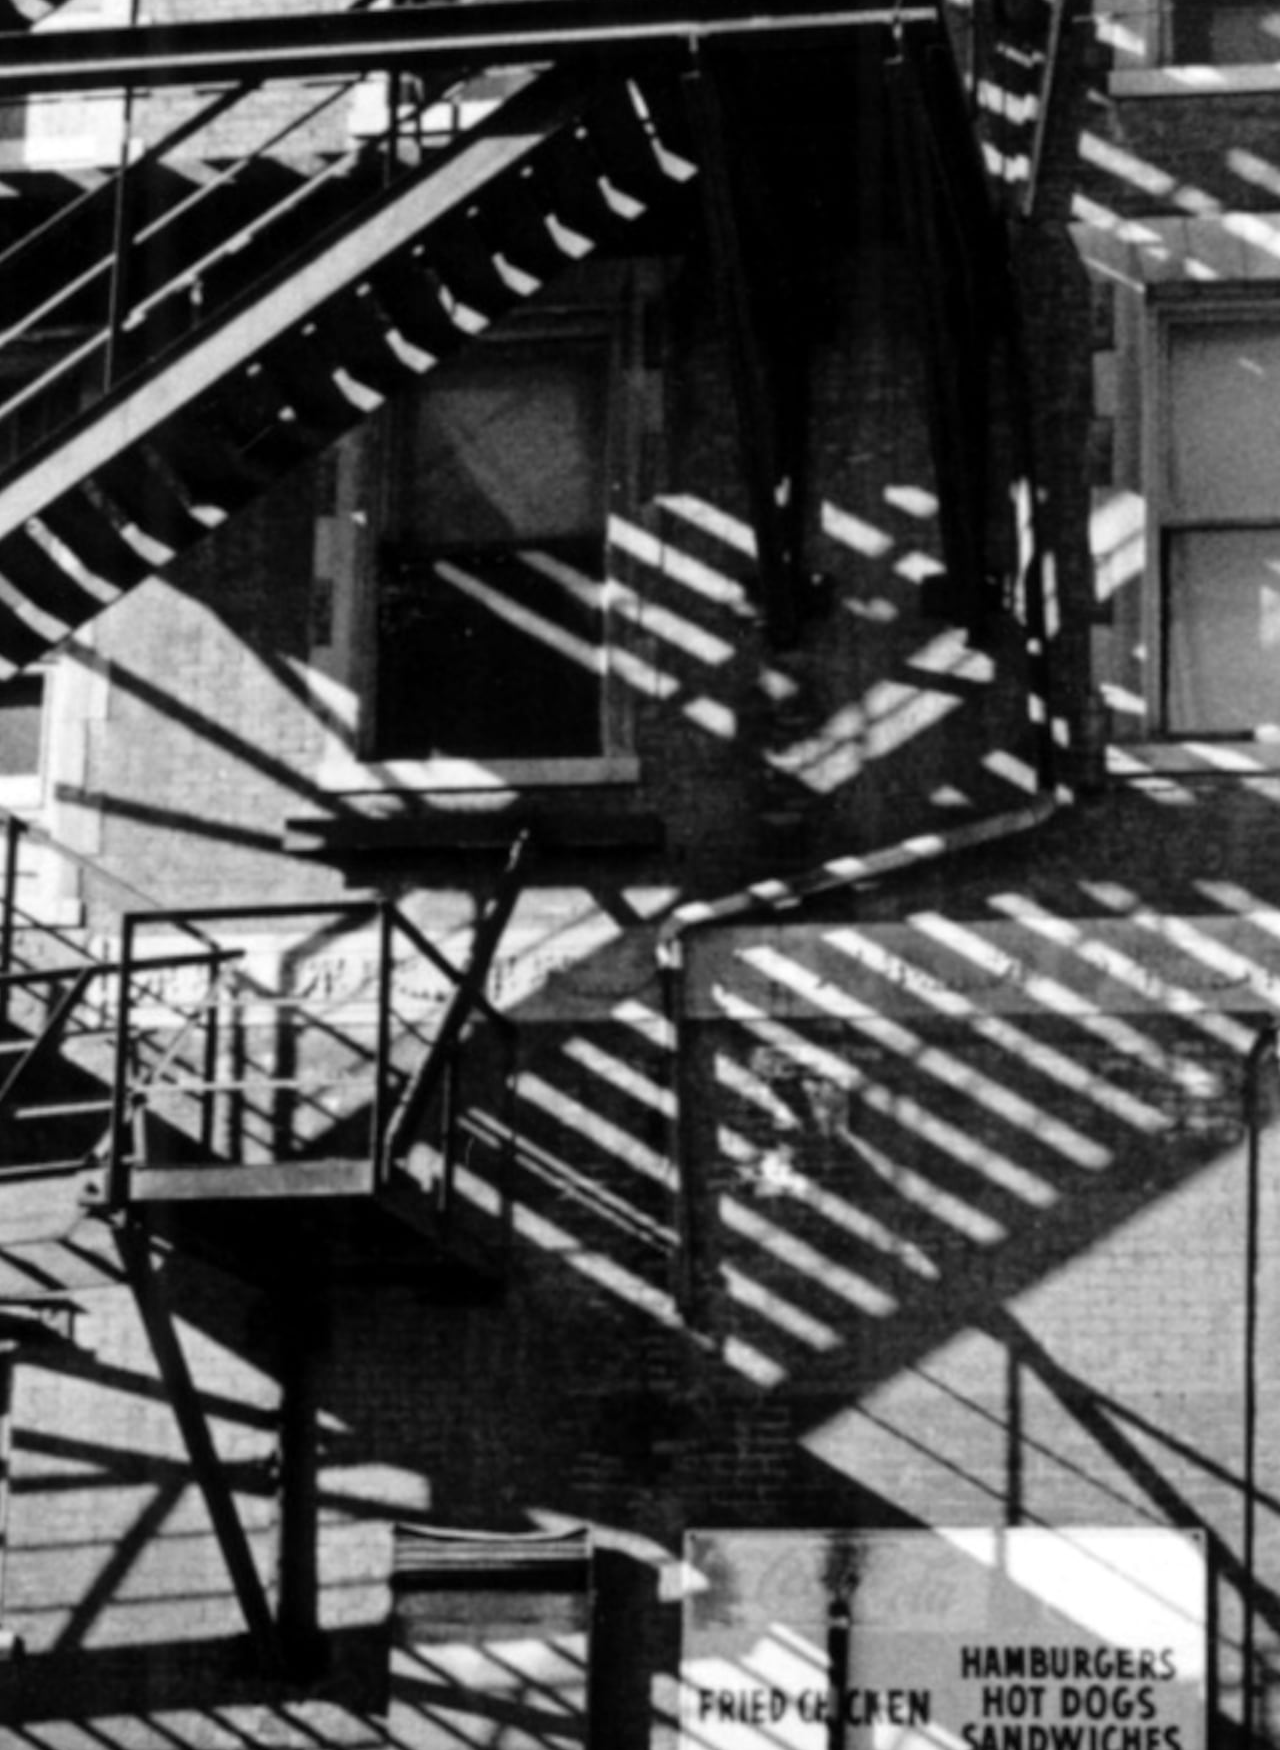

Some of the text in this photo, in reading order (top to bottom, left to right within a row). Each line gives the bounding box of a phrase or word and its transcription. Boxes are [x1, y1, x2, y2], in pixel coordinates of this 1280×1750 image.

[961, 1645, 1177, 1680] HAMBURGERS
[698, 1687, 931, 1727] FRIED CHCKEN
[982, 1684, 1157, 1720] HOT DOGS
